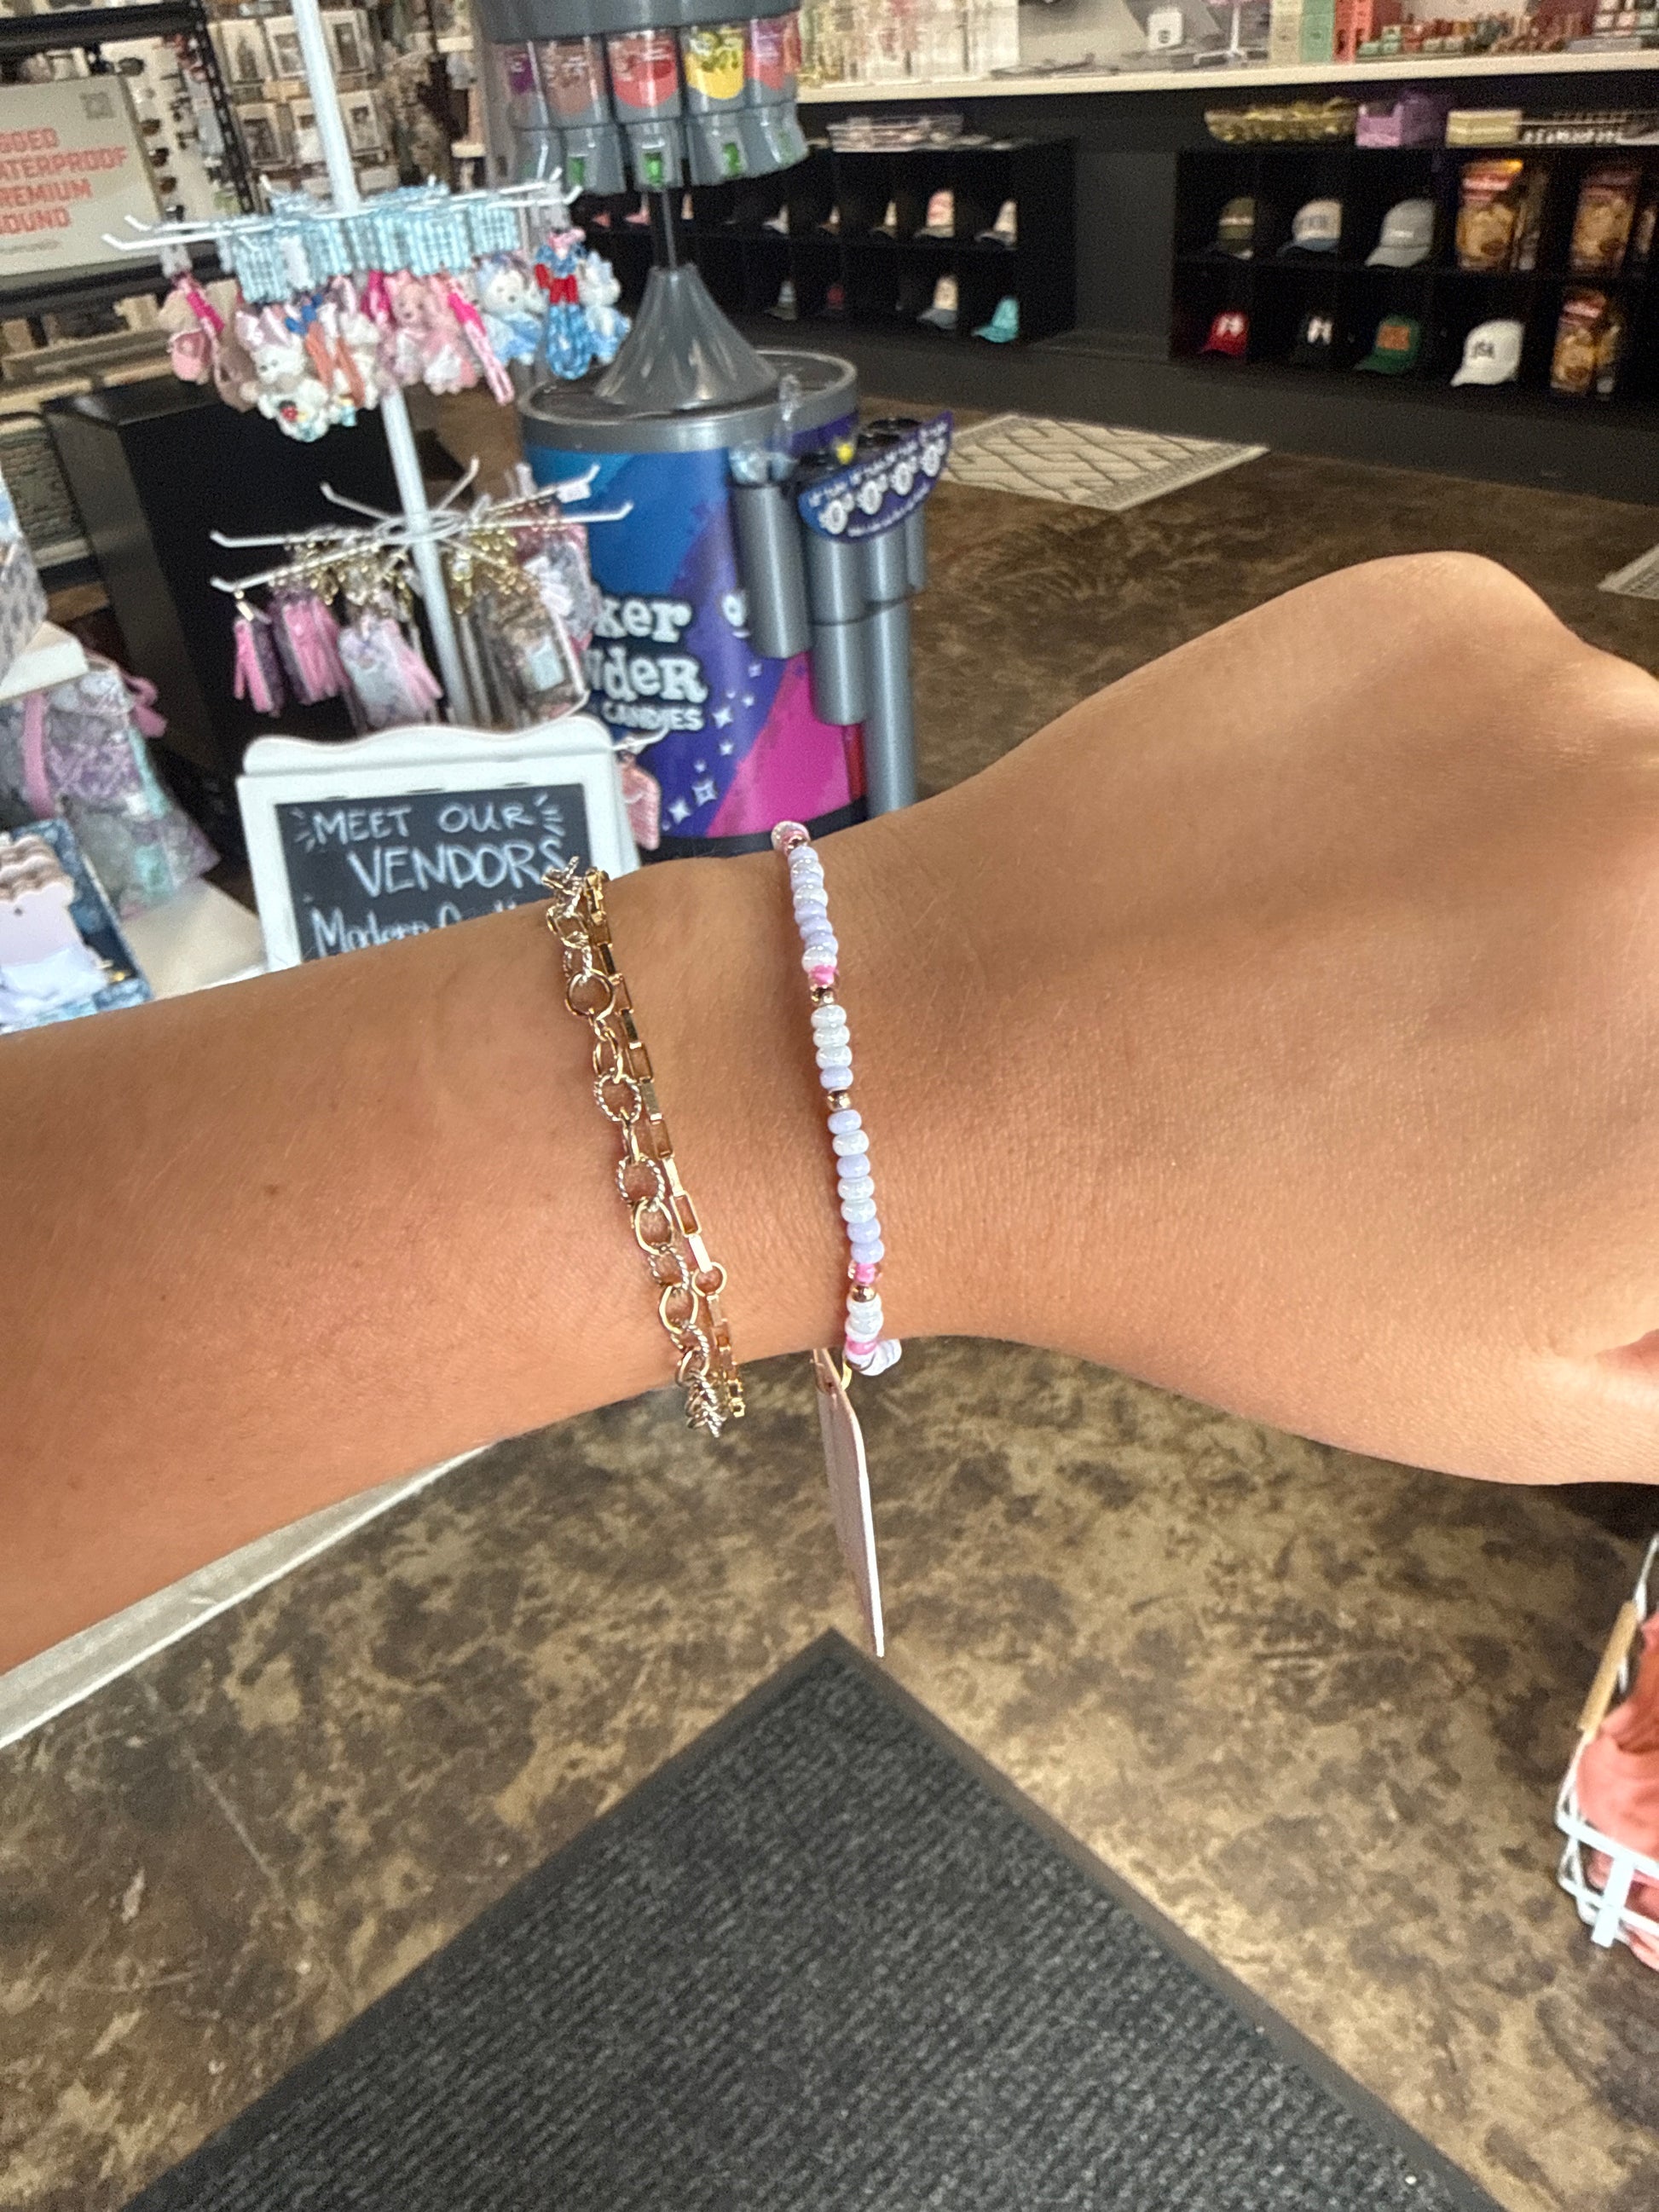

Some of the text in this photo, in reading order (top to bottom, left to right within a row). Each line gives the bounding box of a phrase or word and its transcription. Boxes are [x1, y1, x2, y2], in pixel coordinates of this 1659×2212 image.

[0, 208, 70, 234] OUND
[312, 802, 536, 845] MEET OUR
[348, 836, 565, 897] VENDORS
